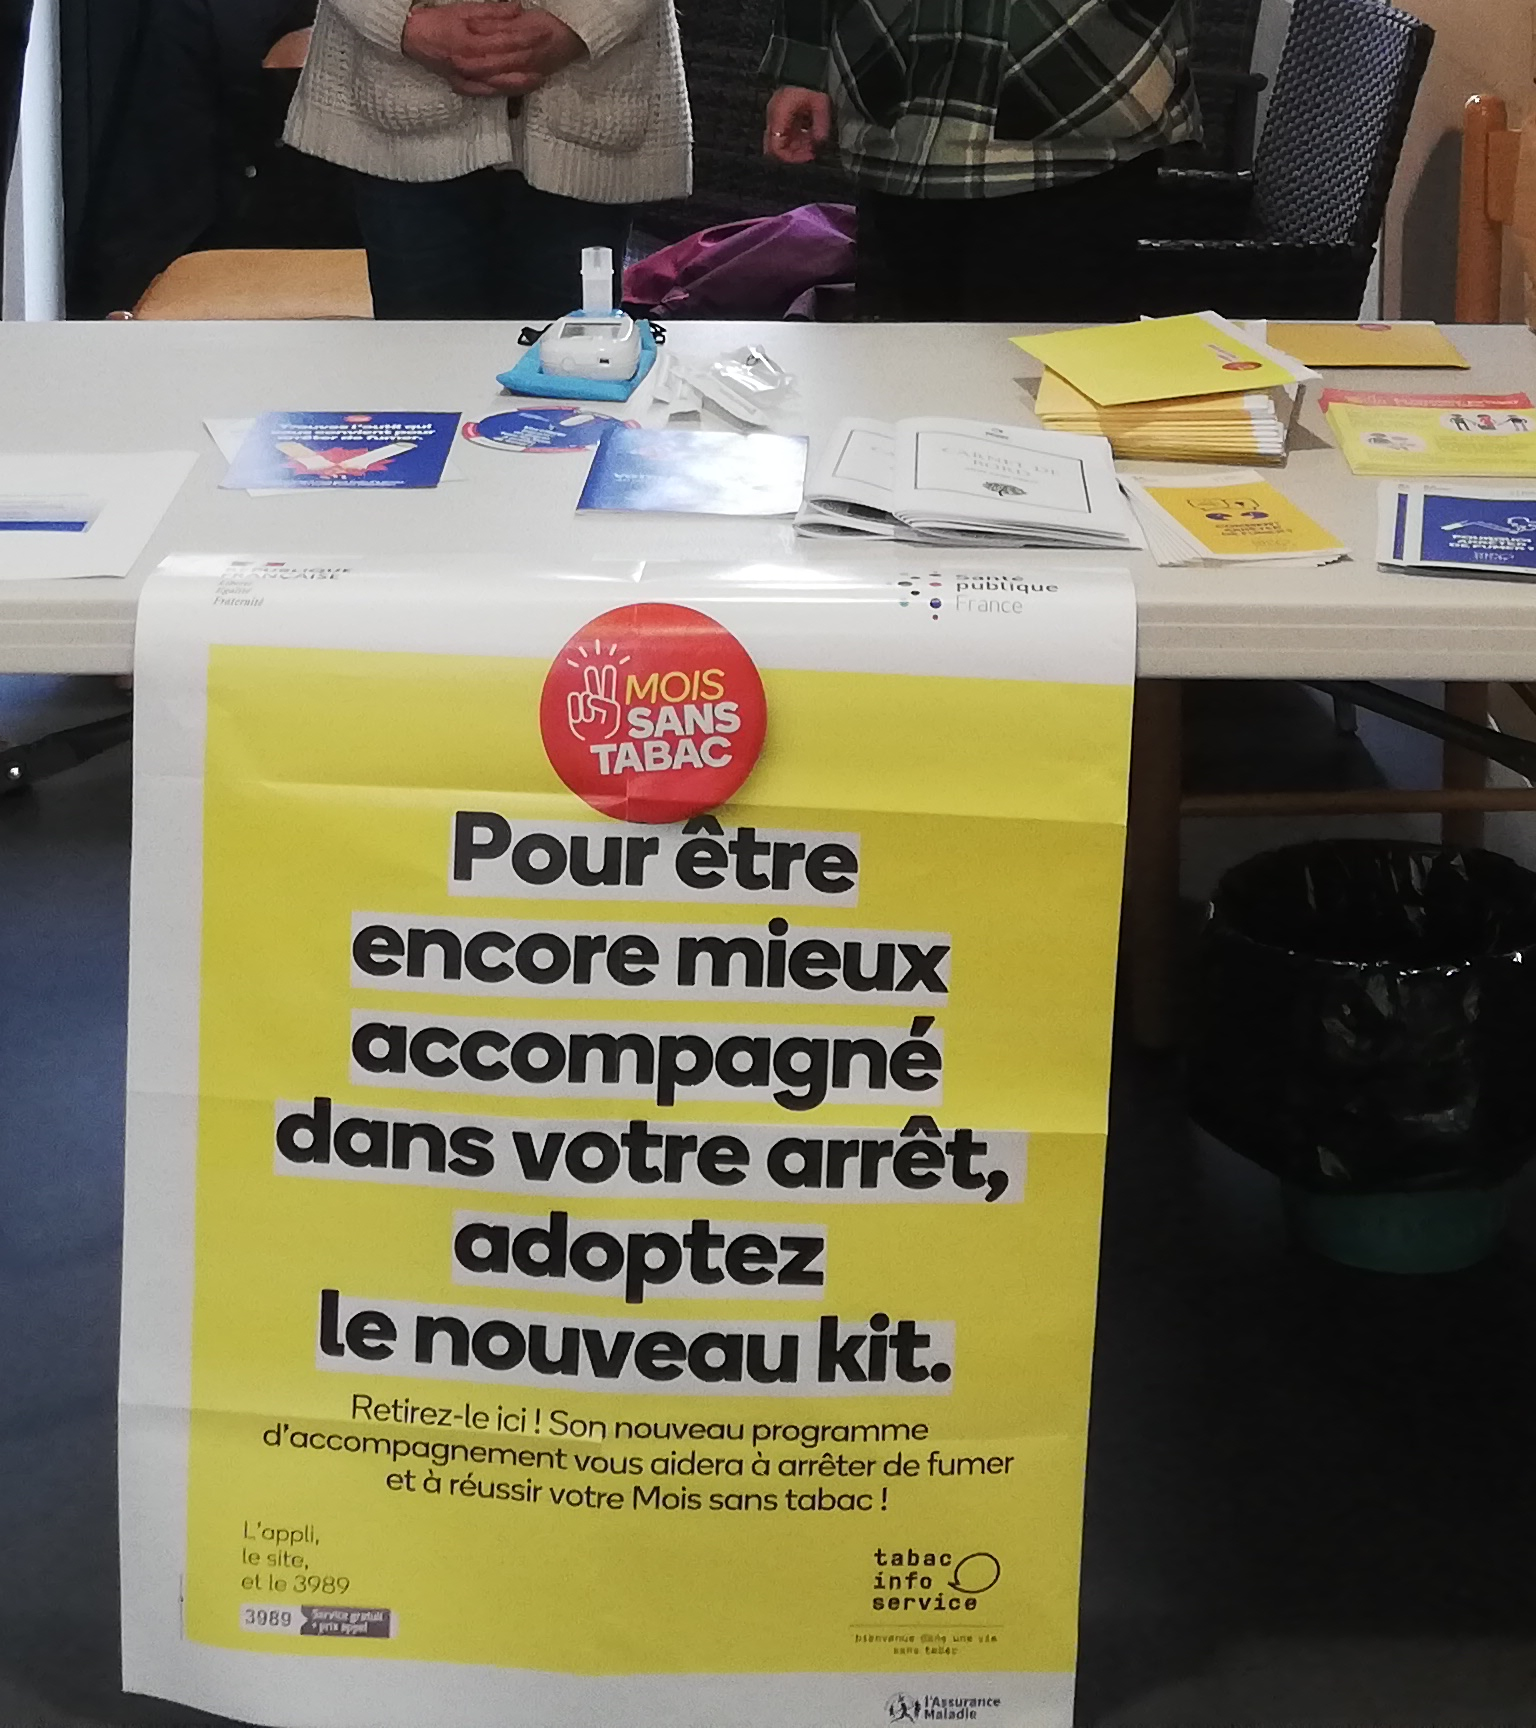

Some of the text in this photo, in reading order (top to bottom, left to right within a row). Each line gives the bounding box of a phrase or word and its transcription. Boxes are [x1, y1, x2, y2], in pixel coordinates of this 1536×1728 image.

[213, 596, 265, 607] Fraternité
[956, 582, 1059, 594] publique
[956, 595, 1023, 614] France
[625, 668, 725, 706] MOIS
[627, 701, 741, 739] SANS
[590, 736, 733, 775] TABAC
[454, 810, 859, 894] Pour être
[352, 917, 951, 993] encore mieux
[352, 1016, 942, 1111] accompagné
[276, 1096, 1009, 1203] dans votre arrêt,
[454, 1210, 825, 1304] adoptez
[320, 1288, 952, 1383] le nouveau kit.
[352, 1393, 929, 1449] Retirez-le ici ! Son nouveau programme
[263, 1423, 1015, 1478] d'accompagnement vous aidera à arrêter de fumer
[386, 1469, 889, 1512] et à réussir votre Mois sans tabac !
[242, 1520, 320, 1546] L'appli,
[242, 1548, 309, 1571] le site,
[874, 1548, 952, 1567] tabac
[241, 1574, 350, 1595] et le 3989
[873, 1571, 932, 1590] info
[872, 1592, 978, 1611] service
[245, 1608, 293, 1628] 3989
[924, 1694, 1002, 1708] l'Assurance
[924, 1708, 977, 1720] Maladie
